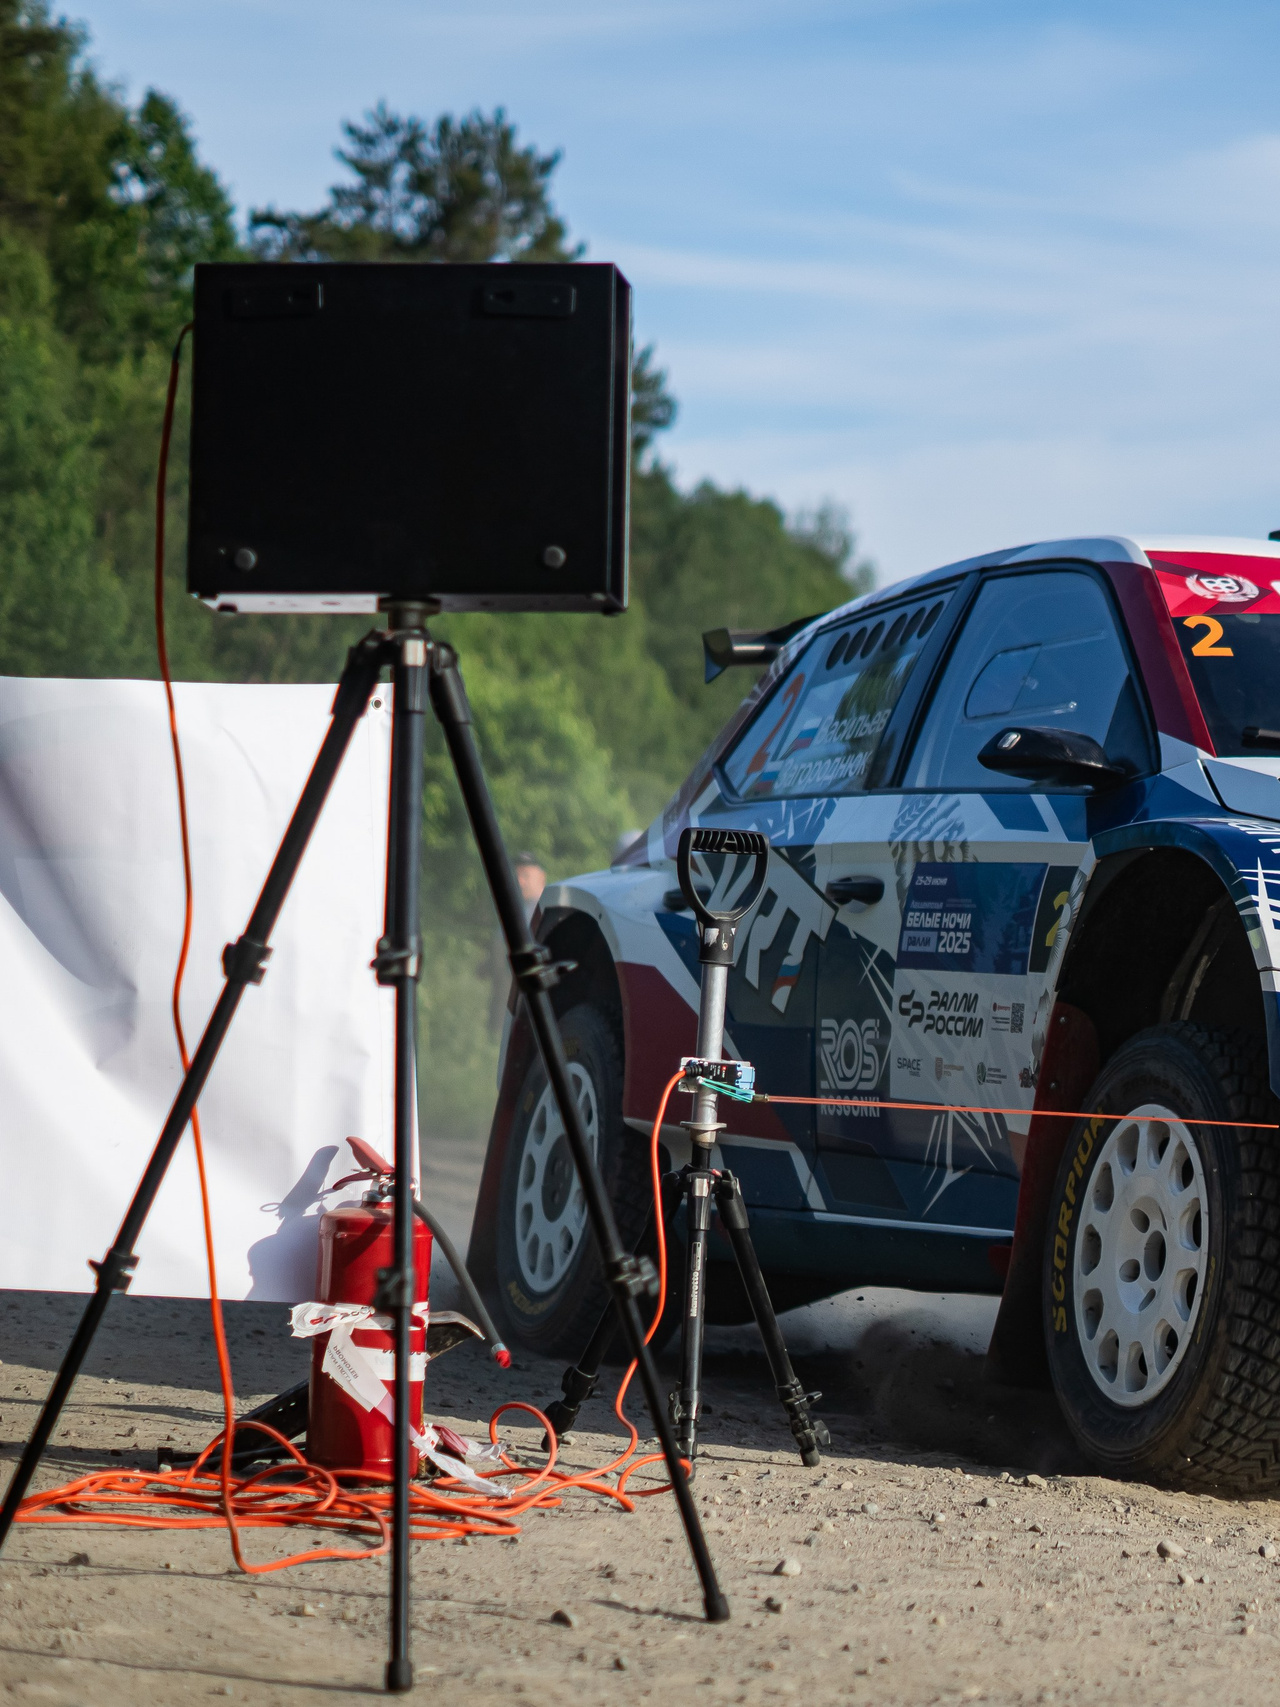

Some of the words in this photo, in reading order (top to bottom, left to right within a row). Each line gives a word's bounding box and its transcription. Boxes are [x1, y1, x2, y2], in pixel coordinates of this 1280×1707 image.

[1183, 615, 1234, 657] 2
[906, 911, 941, 928] БЕЛЫЕ
[942, 912, 971, 929] НОЧИ
[937, 932, 972, 953] 2025
[928, 990, 979, 1014] РАЛЛИ
[923, 1013, 984, 1038] РОССИИ
[896, 1057, 922, 1071] SPACE
